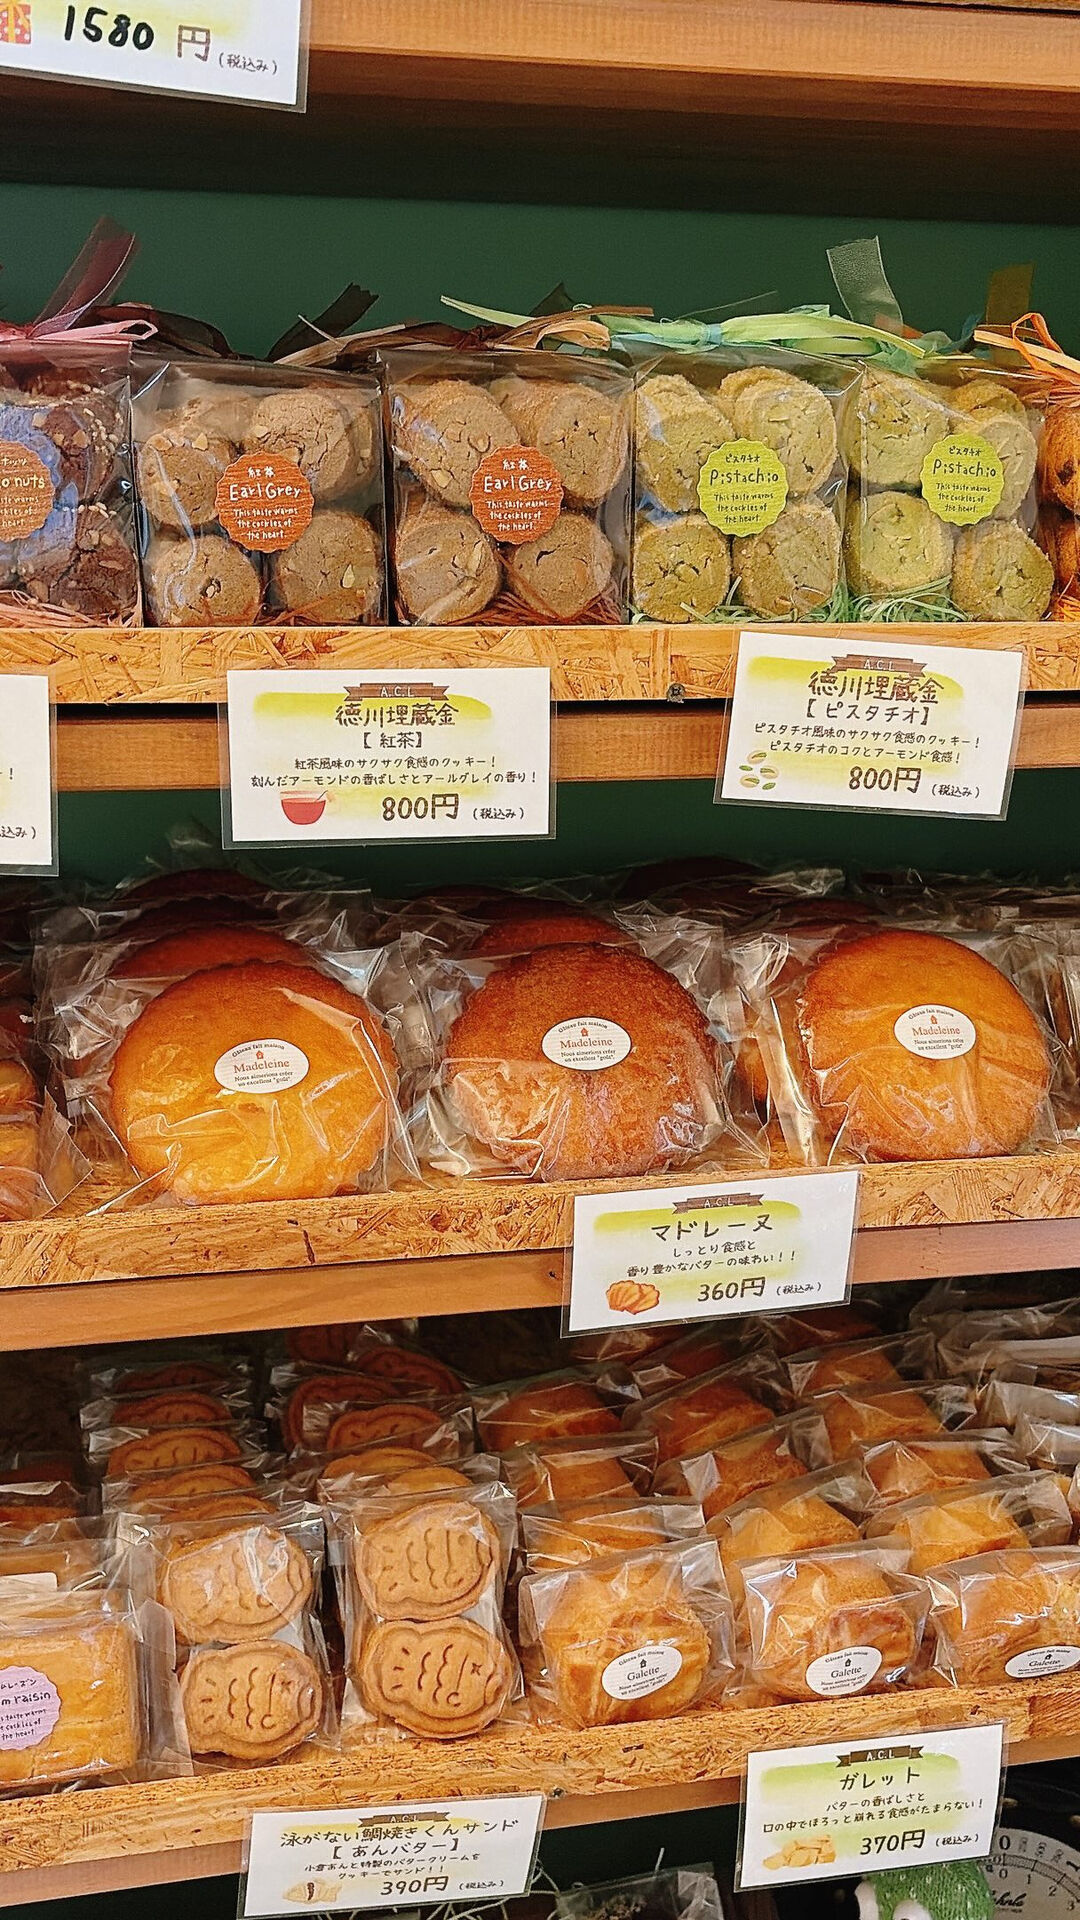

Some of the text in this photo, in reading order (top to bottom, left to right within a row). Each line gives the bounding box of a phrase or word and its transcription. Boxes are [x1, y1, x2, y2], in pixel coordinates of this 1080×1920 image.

[64, 6, 278, 75] 1580 円 （税込み）
[949, 445, 982, 456] ピスタチオ
[502, 458, 530, 470] 紅茶
[725, 453, 760, 463] ピスタチオ
[247, 466, 276, 478] 紅茶
[933, 459, 996, 477] Pistachio
[14, 474, 45, 489] nuts
[484, 475, 552, 493] Earl Grey
[710, 468, 779, 486] Pistachio
[229, 482, 301, 501] Earl Grey
[952, 483, 969, 491] taste
[970, 485, 991, 493] warms
[714, 492, 774, 501] This taste warms
[950, 494, 976, 502] cockles
[977, 495, 984, 503] of
[24, 506, 33, 515] of
[486, 500, 548, 509] This taste warms
[717, 503, 767, 512] the cockles of
[944, 504, 955, 512] the
[234, 507, 298, 517] This taste warms
[490, 510, 541, 520] the cockles of
[725, 515, 736, 523] the
[237, 518, 292, 528] the cockles of
[497, 523, 510, 532] the
[247, 531, 260, 540] the
[807, 671, 944, 704] 徳川埋蔵金
[335, 702, 459, 727] 徳川埋蔵金
[754, 722, 980, 749] ピスタチオ風味のサクサク食感のクッキー！
[769, 740, 961, 765] ピスタチオのコクとアーモンド食感！
[294, 755, 496, 771] 紅茶風味のサクサク食感のクッキー！
[251, 771, 536, 788] 刻んだアーモンドの香ばしさとアールグレイの香り！
[848, 766, 981, 799] 800円 （税込み）
[382, 792, 525, 822] 800円 （税込み）
[912, 1026, 961, 1037] Madeleine
[559, 1037, 613, 1049] Madeleine
[233, 1058, 290, 1074] Madeleine
[651, 1213, 773, 1242] マドレーヌ
[673, 1239, 756, 1258] しっとり食感と
[627, 1250, 796, 1277] 香り豊かなバターの味わい！！
[697, 1276, 822, 1303] 360円 （税込み）
[627, 1666, 660, 1681] Galette
[830, 1667, 862, 1678] Galette
[14, 1692, 51, 1704] raisin
[6, 1713, 23, 1721] taste
[25, 1708, 46, 1718] warms
[34, 1717, 41, 1725] of
[1, 1732, 13, 1741] the
[839, 1766, 920, 1791] ガレット
[826, 1792, 926, 1812] バターの香ばしさと
[763, 1798, 984, 1833] 口の中でほろっと崩れる食感がたまらない！
[280, 1819, 519, 1848] 泳がない鯛焼きくんサンド
[859, 1828, 979, 1855] 370円 （税込み）
[999, 1835, 1011, 1850] 0
[304, 1852, 480, 1872] 小倉あんと特製のバタークリームを
[999, 1868, 1008, 1879] 0
[1027, 1873, 1031, 1884] 1
[380, 1876, 449, 1896] 390円
[1048, 1885, 1057, 1897] 2
[1066, 1901, 1075, 1911] 3
